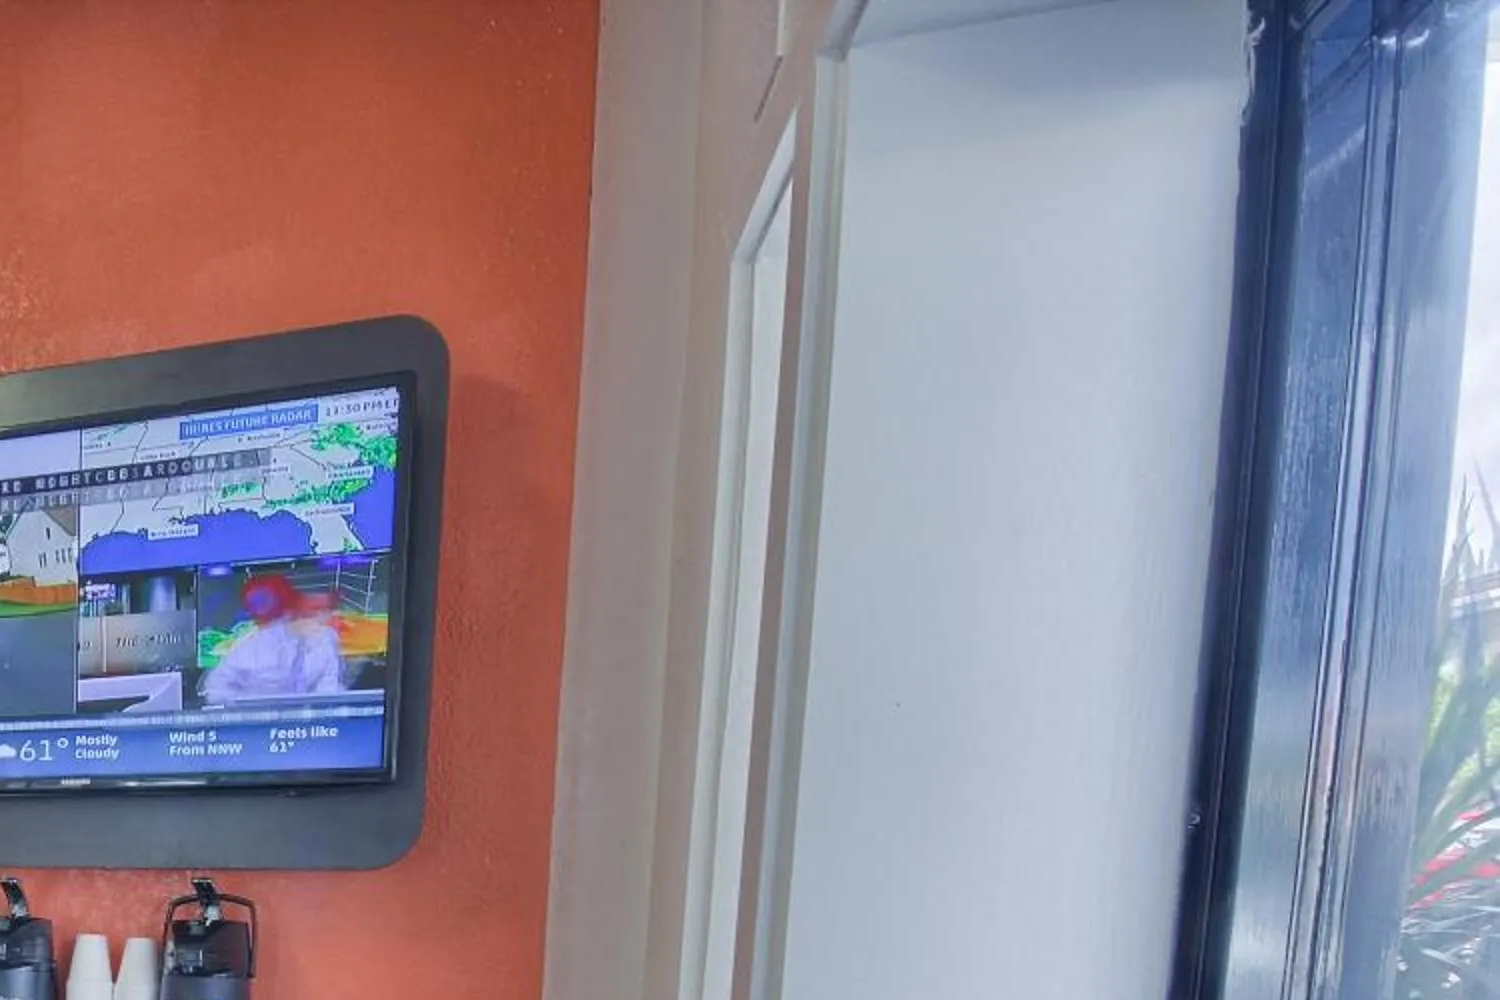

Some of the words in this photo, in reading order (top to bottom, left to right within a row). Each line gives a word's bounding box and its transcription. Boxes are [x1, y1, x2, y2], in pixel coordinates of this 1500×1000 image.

[224, 414, 267, 431] FUTURE
[270, 408, 312, 425] RADAR
[169, 730, 204, 743] Wind
[269, 726, 307, 740] Feels
[310, 725, 339, 738] like
[75, 734, 118, 748] Mostly
[75, 747, 119, 760] Cloudy
[169, 744, 205, 757] From
